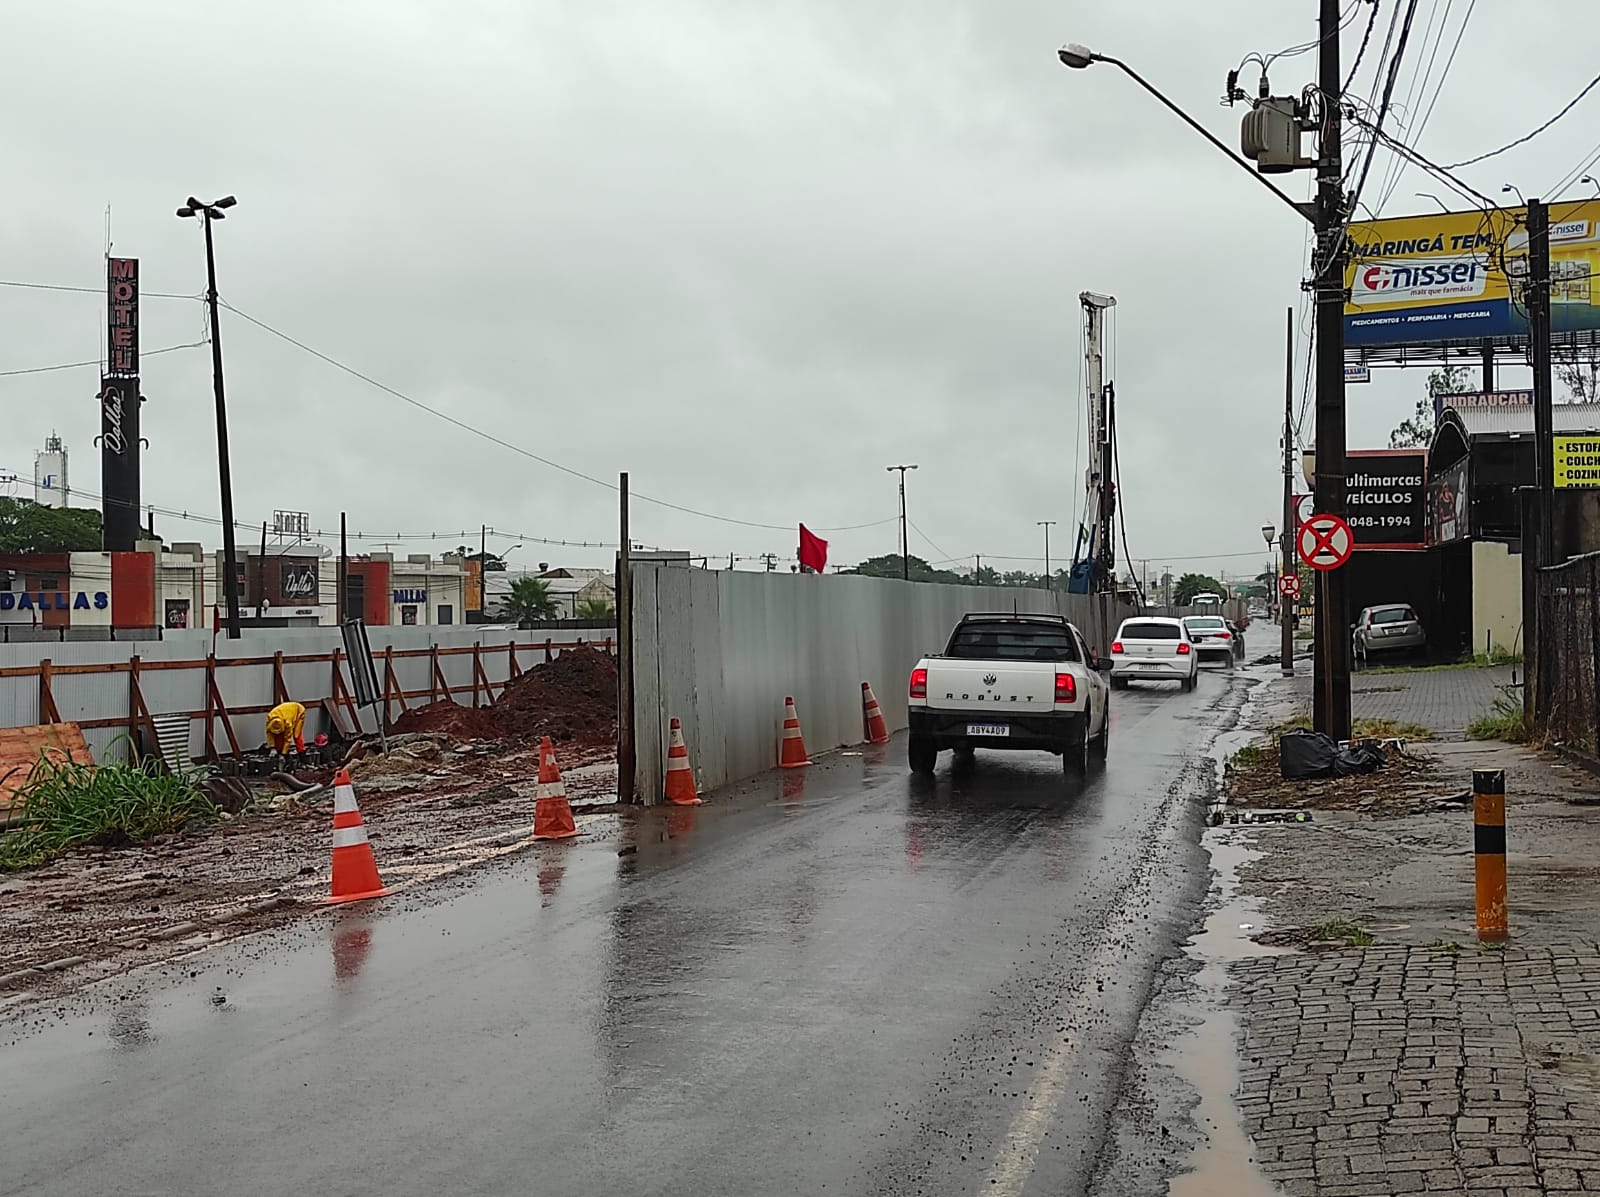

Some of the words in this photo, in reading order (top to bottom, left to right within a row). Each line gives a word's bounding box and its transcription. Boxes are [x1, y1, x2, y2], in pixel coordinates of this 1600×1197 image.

[1352, 233, 1444, 257] MARINGÁ
[1451, 232, 1492, 250] TEM
[112, 259, 134, 369] MOTEL
[1351, 317, 1400, 327] MEDICAMENTOS
[1406, 313, 1447, 323] PERFUMARIA
[1452, 310, 1491, 320] MERCEARIA
[103, 391, 128, 455] Dallas
[1566, 469, 1600, 480] COZIN
[1346, 516, 1411, 526] 048-1994
[0, 591, 108, 610] DALLAS
[394, 589, 427, 603] DALLAS
[946, 693, 1034, 702] ROBUST
